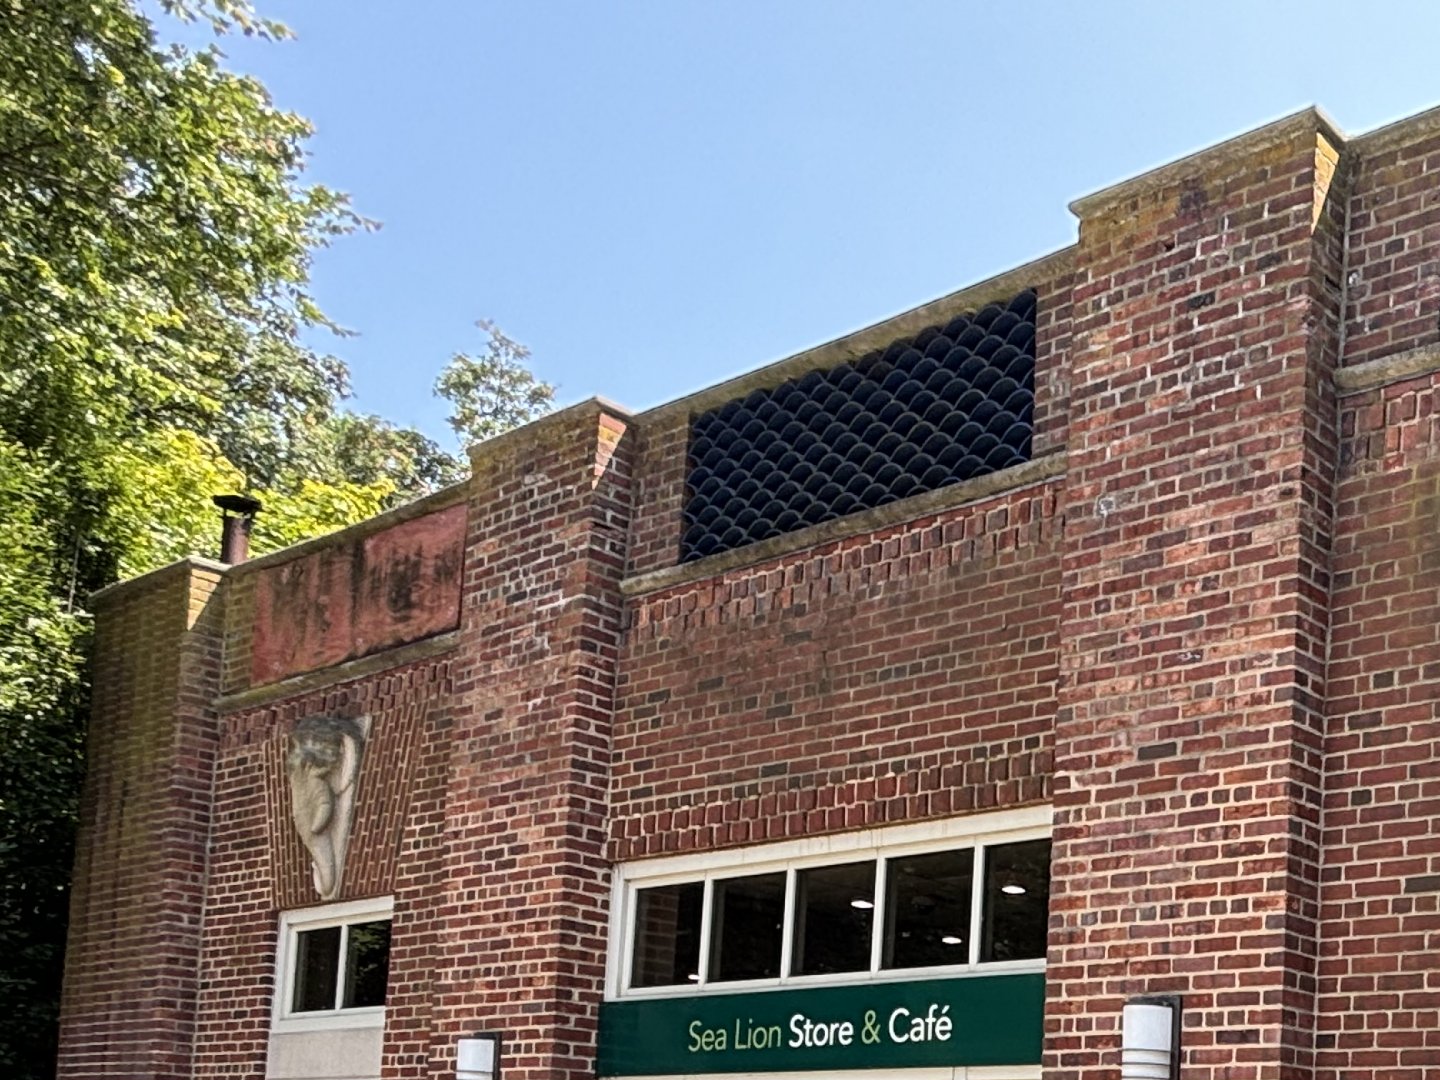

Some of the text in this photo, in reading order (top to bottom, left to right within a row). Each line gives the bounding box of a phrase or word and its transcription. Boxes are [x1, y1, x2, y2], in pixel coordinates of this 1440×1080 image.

[688, 1004, 952, 1052] Sea Lion Store & Café
